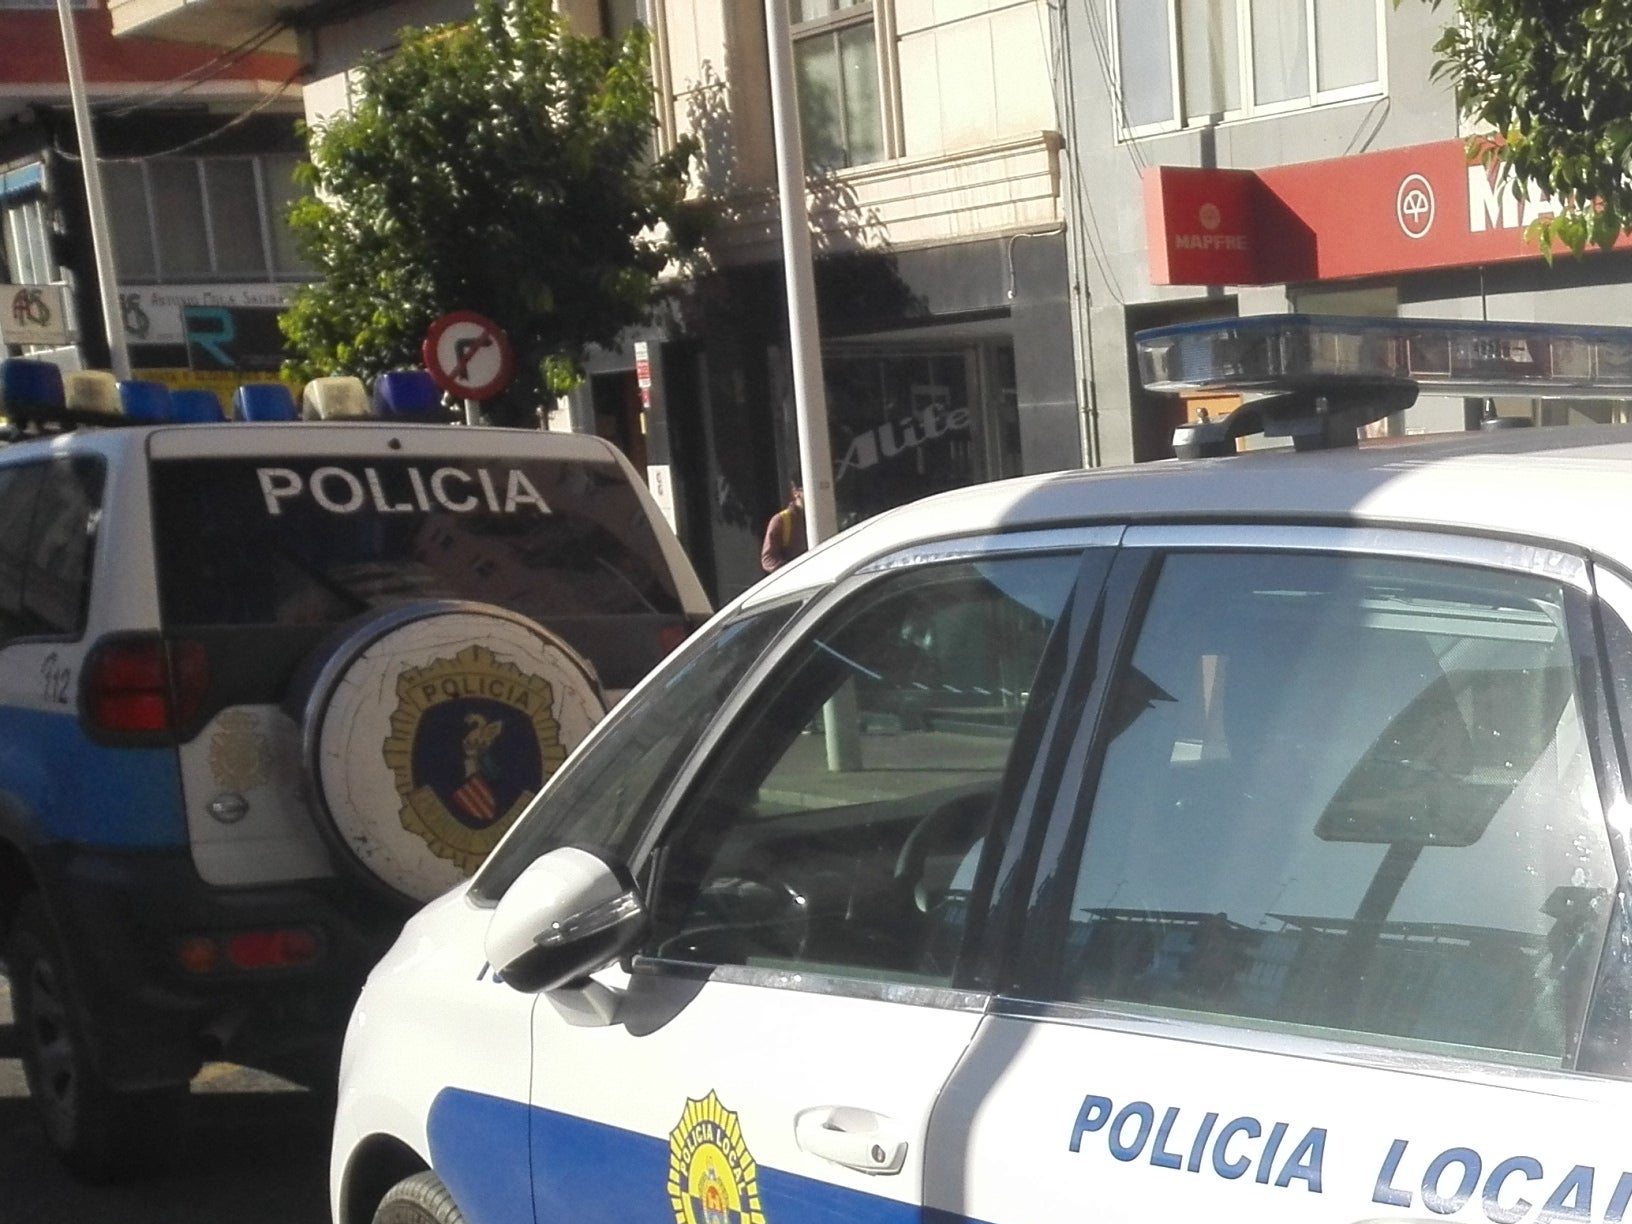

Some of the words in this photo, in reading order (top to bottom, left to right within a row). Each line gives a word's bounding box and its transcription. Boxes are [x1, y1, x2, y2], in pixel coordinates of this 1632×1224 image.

[1174, 233, 1248, 250] MAPFRE
[256, 465, 552, 515] POLICIA
[422, 677, 530, 709] POLICIA
[680, 1123, 713, 1177] POLICIA
[716, 1128, 748, 1196] LOCAL
[1068, 1093, 1328, 1194] POLICIA
